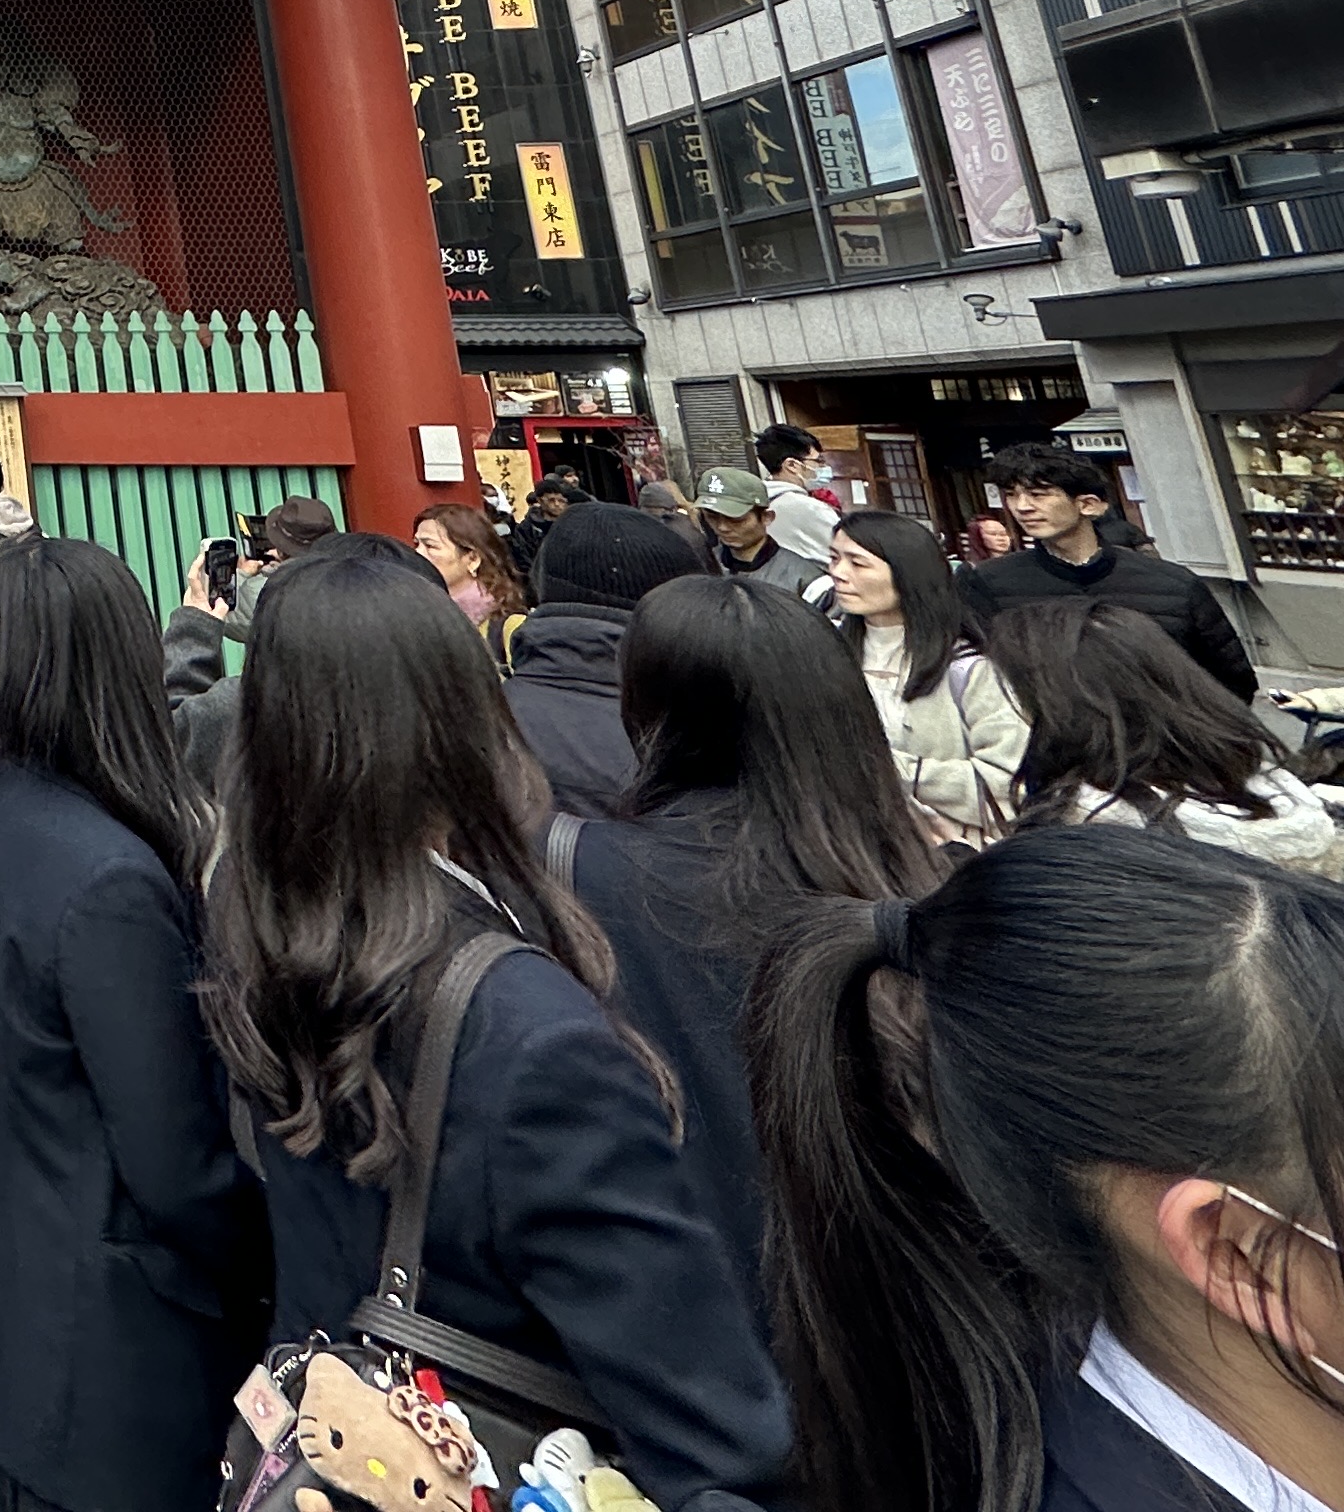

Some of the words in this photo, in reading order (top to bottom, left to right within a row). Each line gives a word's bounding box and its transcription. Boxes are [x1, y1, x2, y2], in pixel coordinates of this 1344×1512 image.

[450, 71, 493, 202] BEEF
[531, 151, 567, 248] 雷門東店
